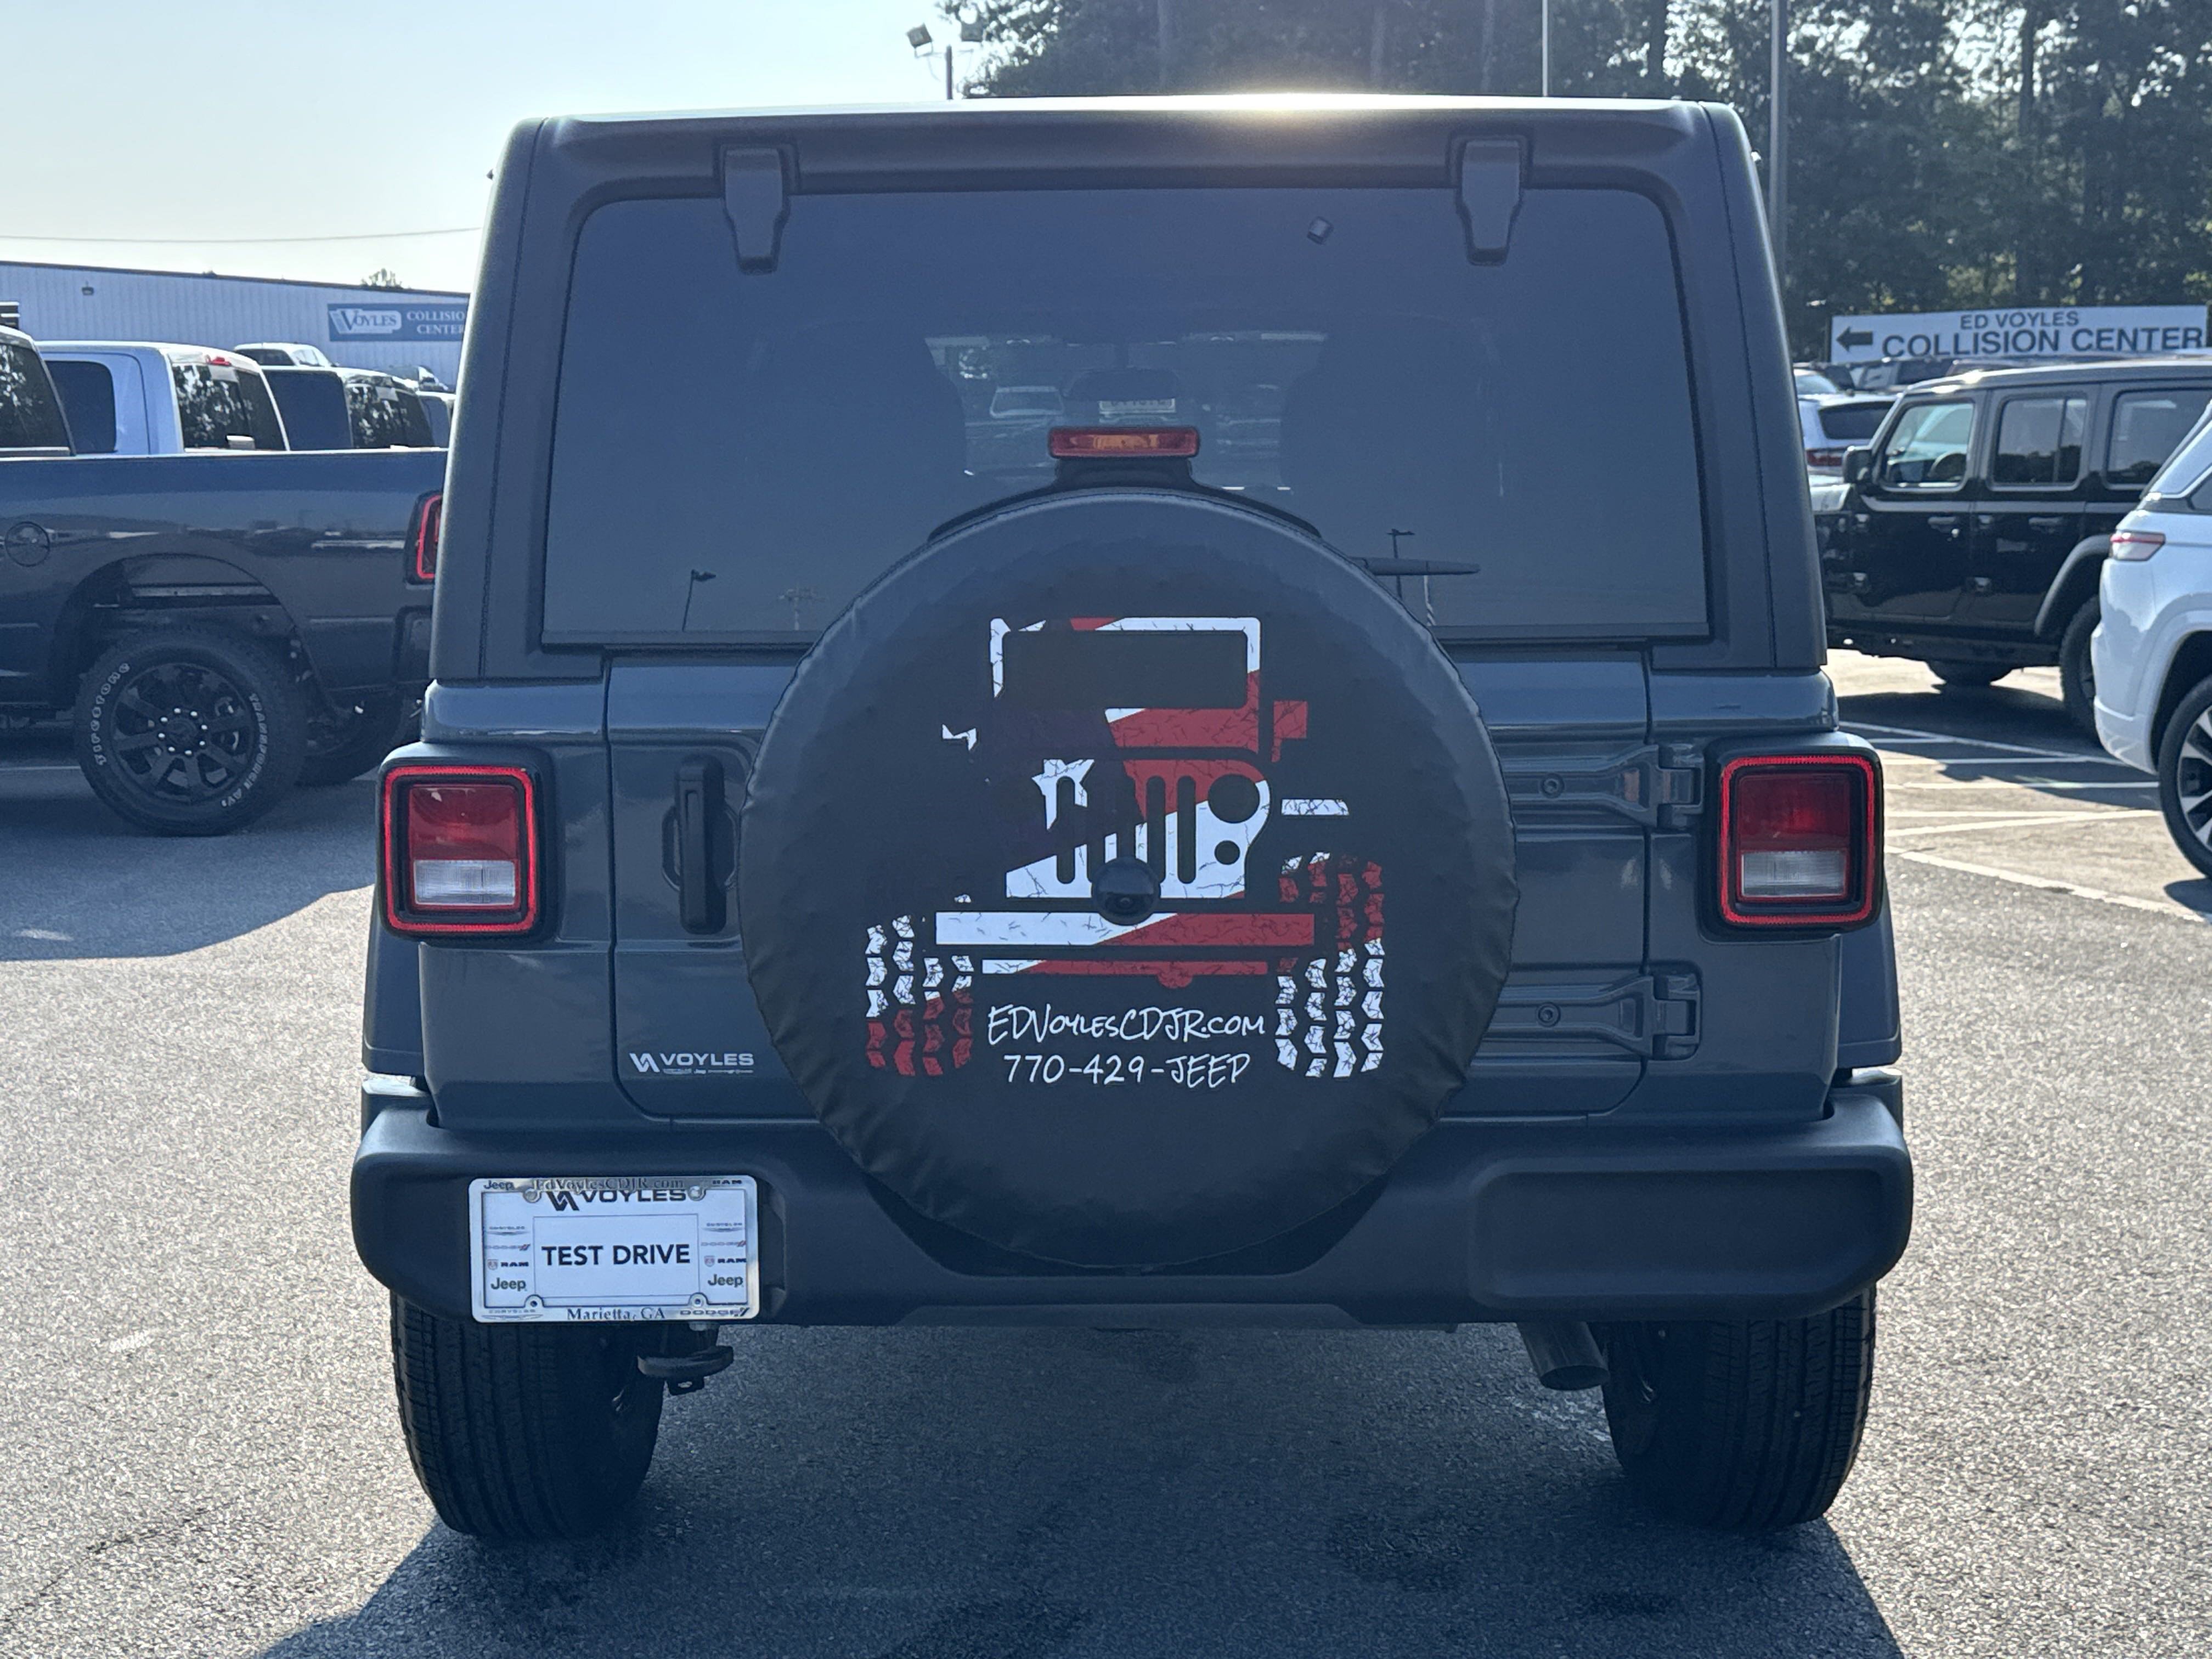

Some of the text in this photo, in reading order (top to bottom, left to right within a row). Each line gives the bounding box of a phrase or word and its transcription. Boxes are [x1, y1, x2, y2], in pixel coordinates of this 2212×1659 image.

[340, 310, 397, 330] VOYLES
[407, 311, 466, 321] COLLISIO
[1960, 311, 2080, 330] ED VOYLES
[1882, 326, 2203, 357] COLLISION CENTER
[660, 1053, 754, 1066] VOYLES
[1003, 1054, 1251, 1088] 770-429-JEEP
[484, 1180, 515, 1190] Jeep
[580, 1189, 686, 1203] VOYLES
[541, 1244, 691, 1266] TEST DRIVE
[490, 1277, 527, 1291] Jeep
[708, 1274, 743, 1288] Jeep
[567, 1307, 637, 1322] Marietta,
[640, 1307, 665, 1320] GA
